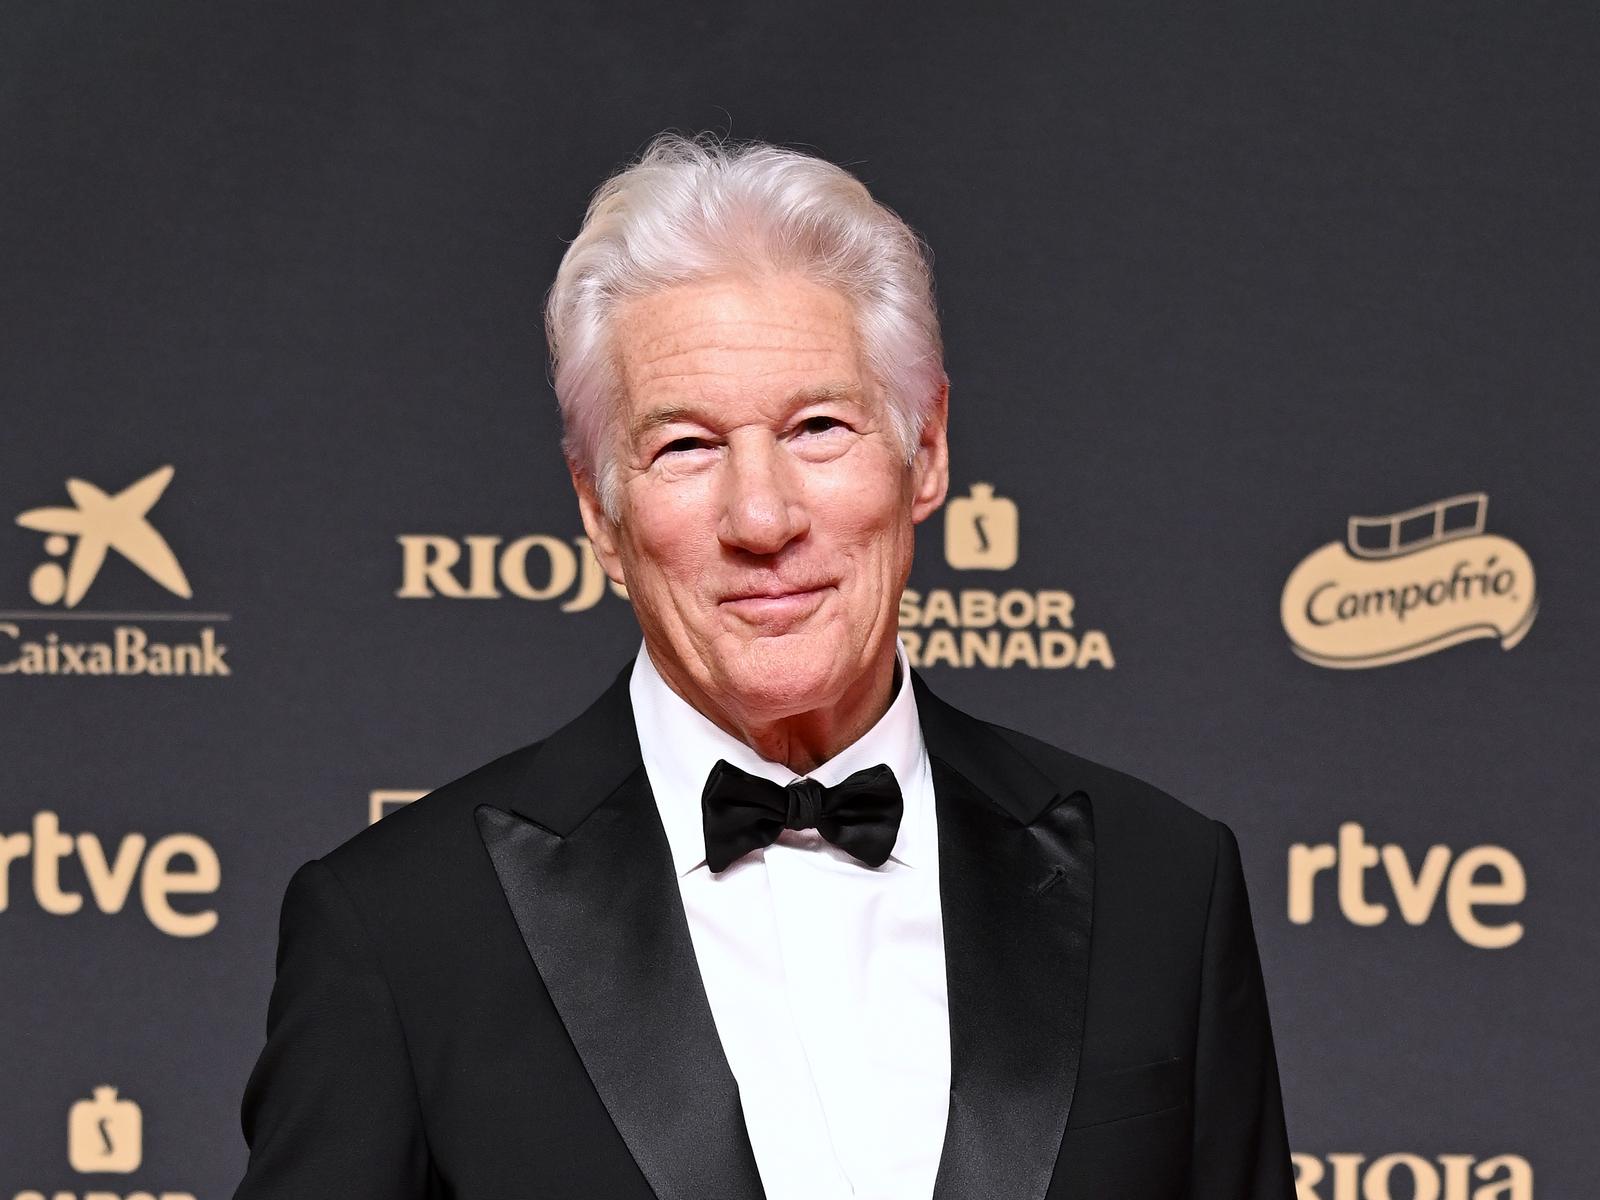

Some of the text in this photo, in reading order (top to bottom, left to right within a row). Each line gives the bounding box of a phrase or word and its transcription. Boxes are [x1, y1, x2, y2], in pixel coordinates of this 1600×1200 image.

[397, 534, 629, 613] RIOJ
[897, 589, 1074, 629] SABOR
[1304, 554, 1516, 627] Campofrío
[898, 630, 1115, 669] ANADA
[0, 811, 222, 938] rtve
[1288, 822, 1526, 948] rtve
